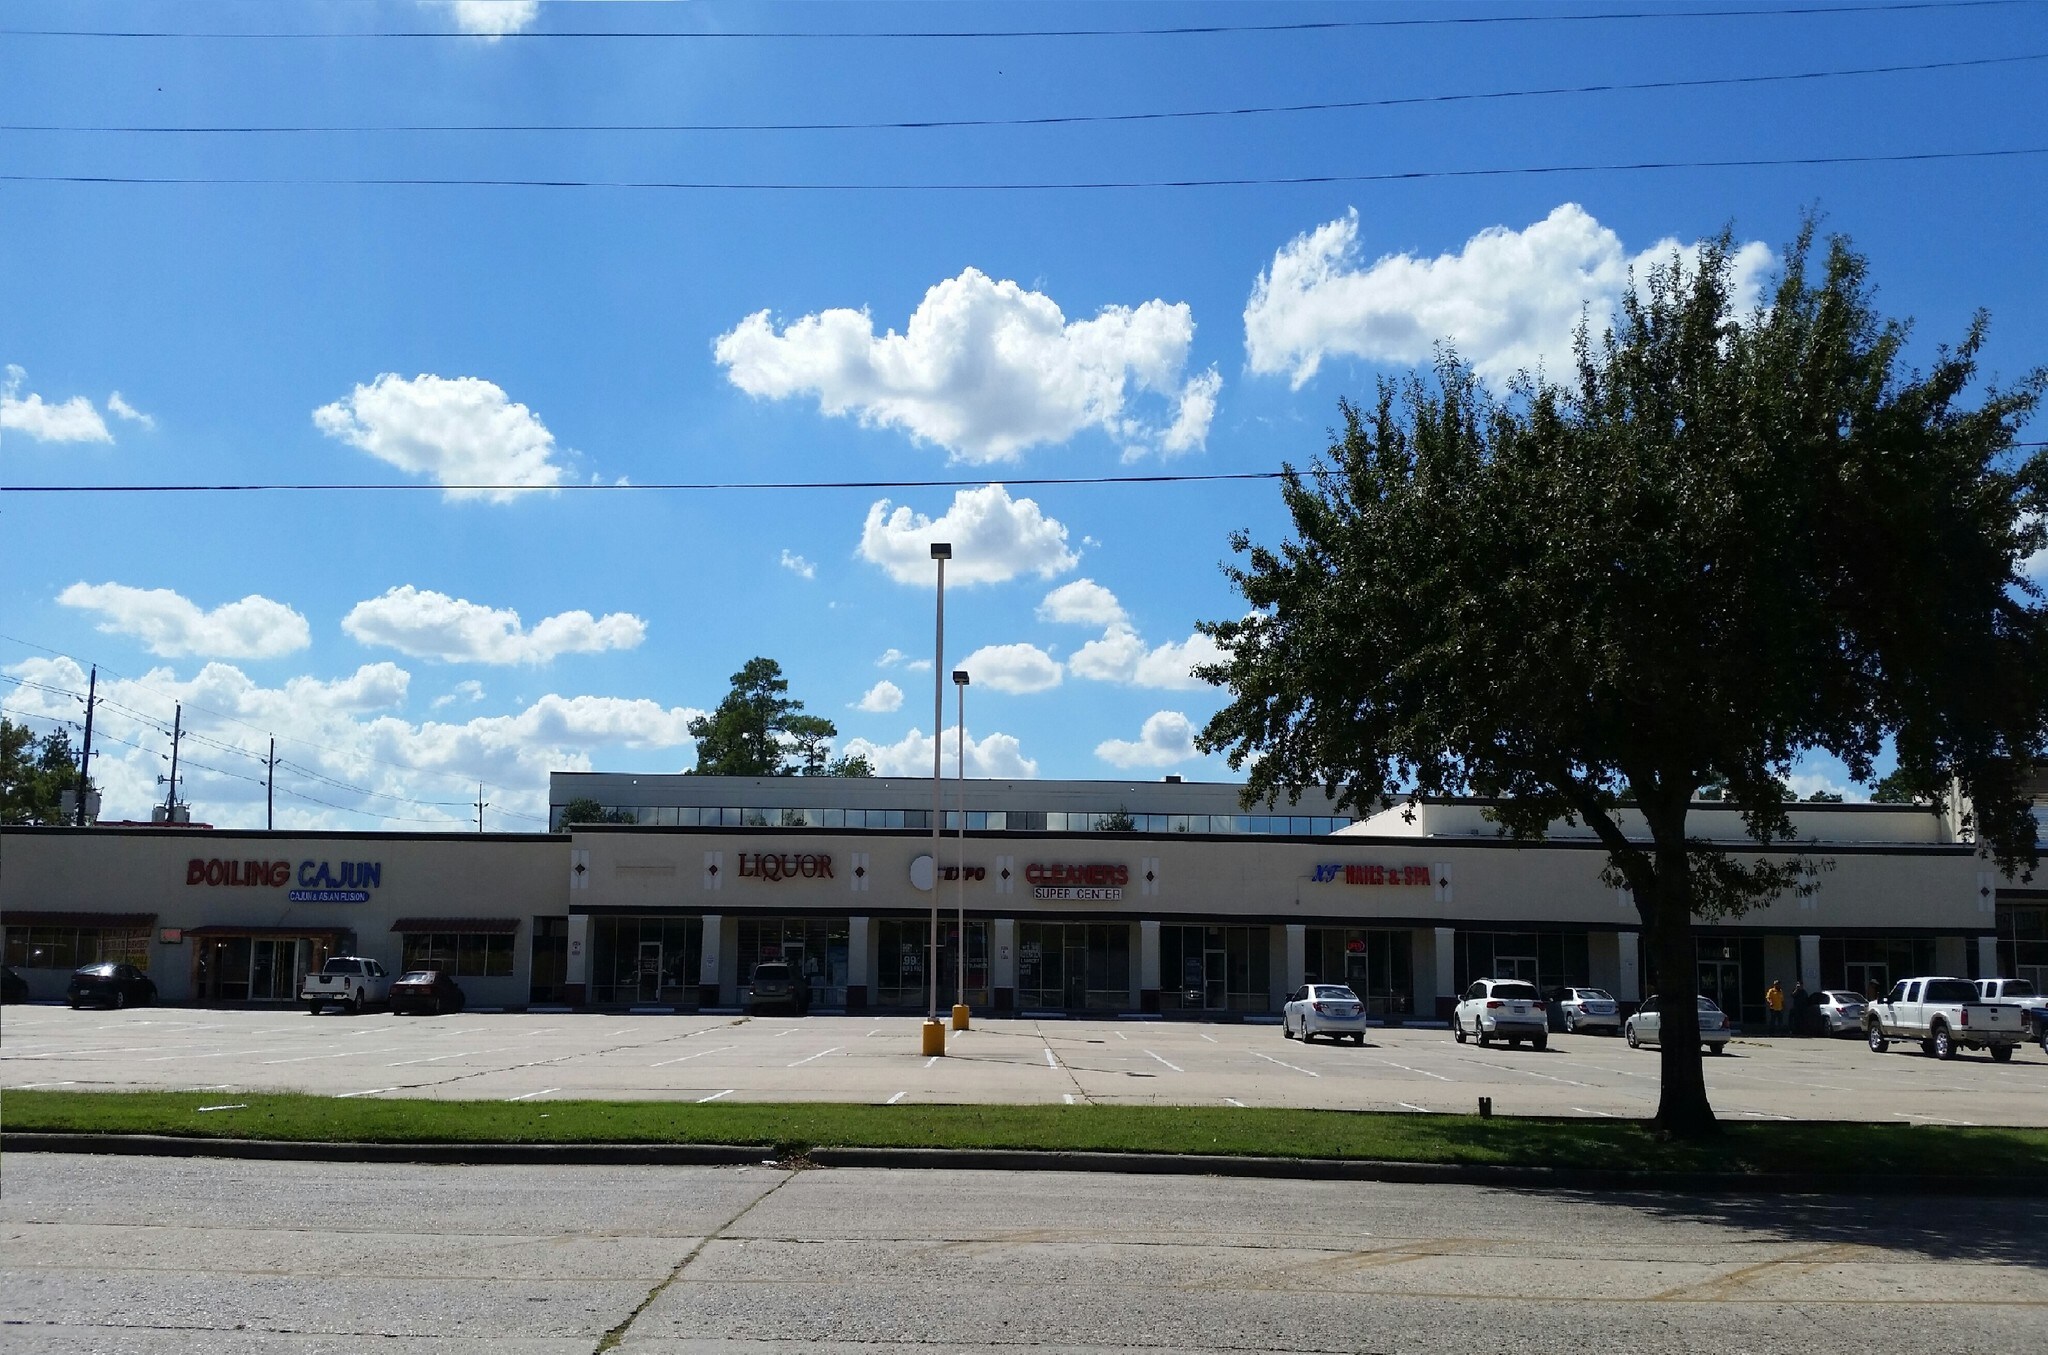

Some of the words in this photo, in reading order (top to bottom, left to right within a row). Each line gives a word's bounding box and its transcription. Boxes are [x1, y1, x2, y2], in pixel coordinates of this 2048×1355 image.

[186, 858, 290, 888] BOILING
[298, 861, 381, 888] CAJUN
[738, 853, 834, 882] LIQUOR
[1025, 863, 1129, 885] CLEANERS
[1346, 865, 1384, 885] NAILS
[1389, 869, 1400, 885] &
[1404, 866, 1431, 885] SPA
[290, 891, 312, 901] CAJUN
[319, 891, 339, 901] ASIAN
[341, 892, 365, 901] FUSION
[1035, 888, 1070, 899] SUPER
